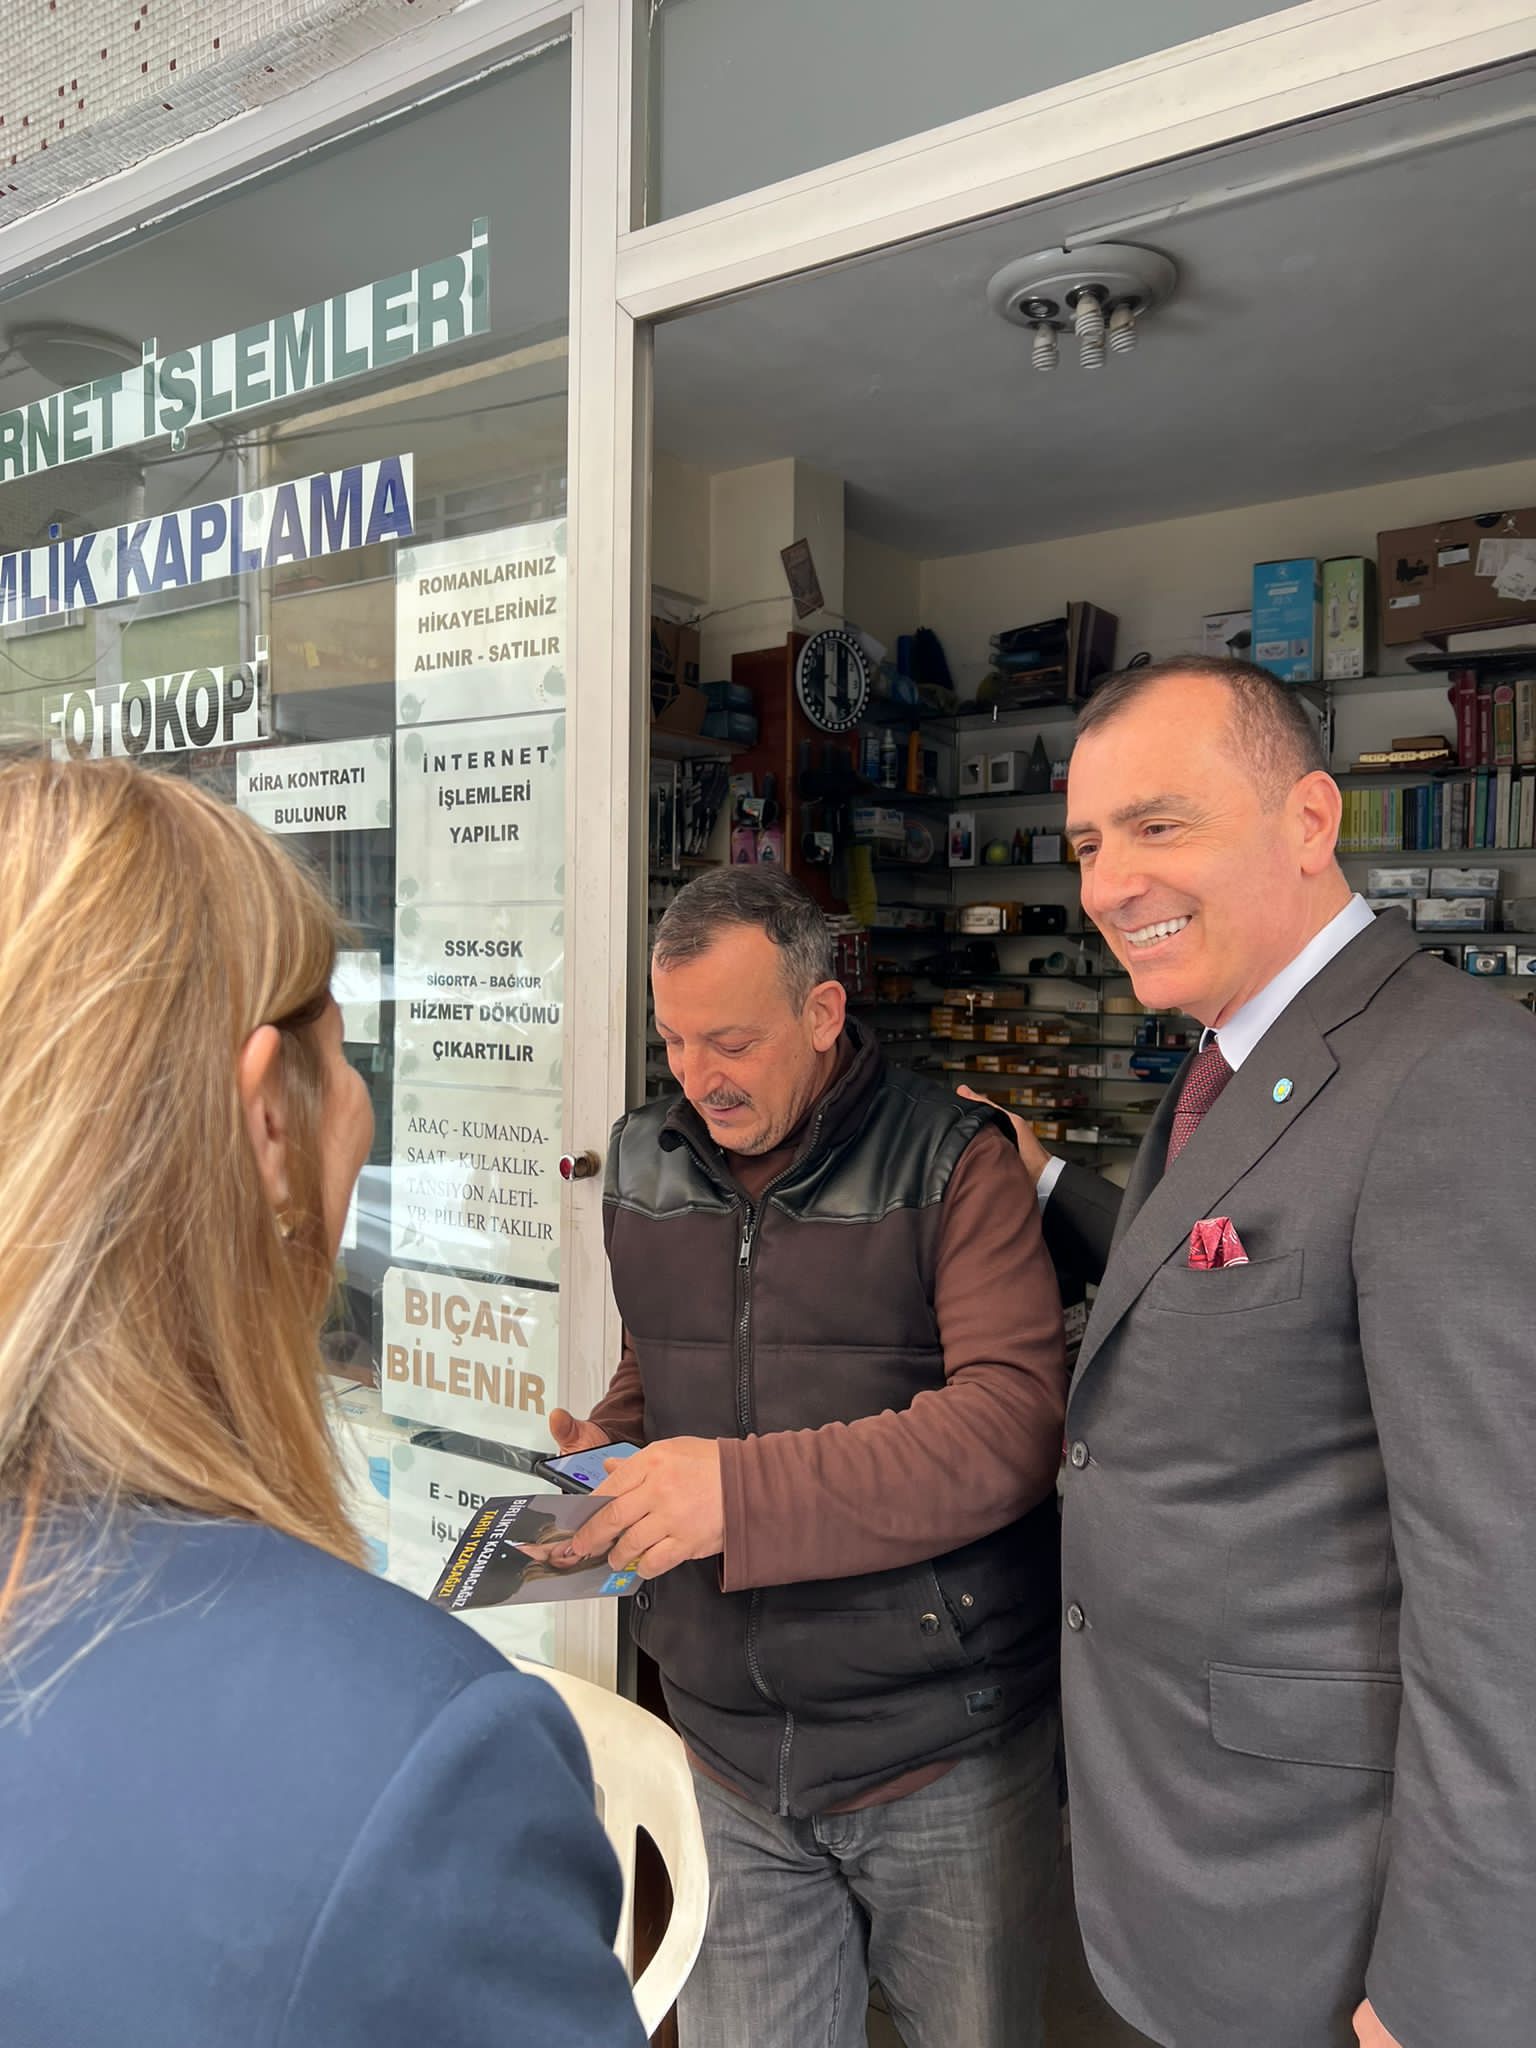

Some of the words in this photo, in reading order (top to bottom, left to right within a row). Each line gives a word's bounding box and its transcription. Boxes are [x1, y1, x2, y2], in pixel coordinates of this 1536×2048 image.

[0, 373, 122, 482] RNET
[142, 217, 489, 450] İŞLEMLERİ
[117, 455, 413, 600] KAPLAMA
[418, 556, 556, 596] ROMANLARINIZ
[418, 595, 557, 634] HİKAYELERİNİZ
[414, 647, 472, 673] ALINIR
[488, 636, 560, 662] SATILIR
[43, 635, 269, 761] FOTOKOPİ
[423, 746, 549, 773] İNTERNET
[249, 771, 283, 792] KİRA
[287, 767, 365, 789] KONTRATI
[438, 780, 531, 810] İŞLEMLERİ
[274, 804, 347, 825] BULUNUR
[450, 823, 519, 844] YAPILIR
[444, 940, 523, 957] SSK-SGK
[427, 972, 478, 987] SİGORTA
[490, 974, 542, 989] BAĞKUR
[410, 1000, 474, 1020] HİZMET
[479, 1002, 560, 1024] DÖKÜMÜ
[433, 1040, 534, 1062] ÇIKARTILIR
[407, 1117, 449, 1139] ARAÇ
[462, 1121, 549, 1144] KUMANDA-
[407, 1147, 446, 1165] SAAT
[407, 1178, 484, 1201] TANSİYON
[434, 1207, 486, 1231] PİLLER
[490, 1215, 553, 1240] TAKILIR
[404, 1287, 529, 1347] BIÇAK
[386, 1338, 546, 1416] BİLENİR
[429, 1482, 440, 1500] E
[470, 1509, 499, 1539] TARİH
[489, 1499, 528, 1540] BİRLİKTE
